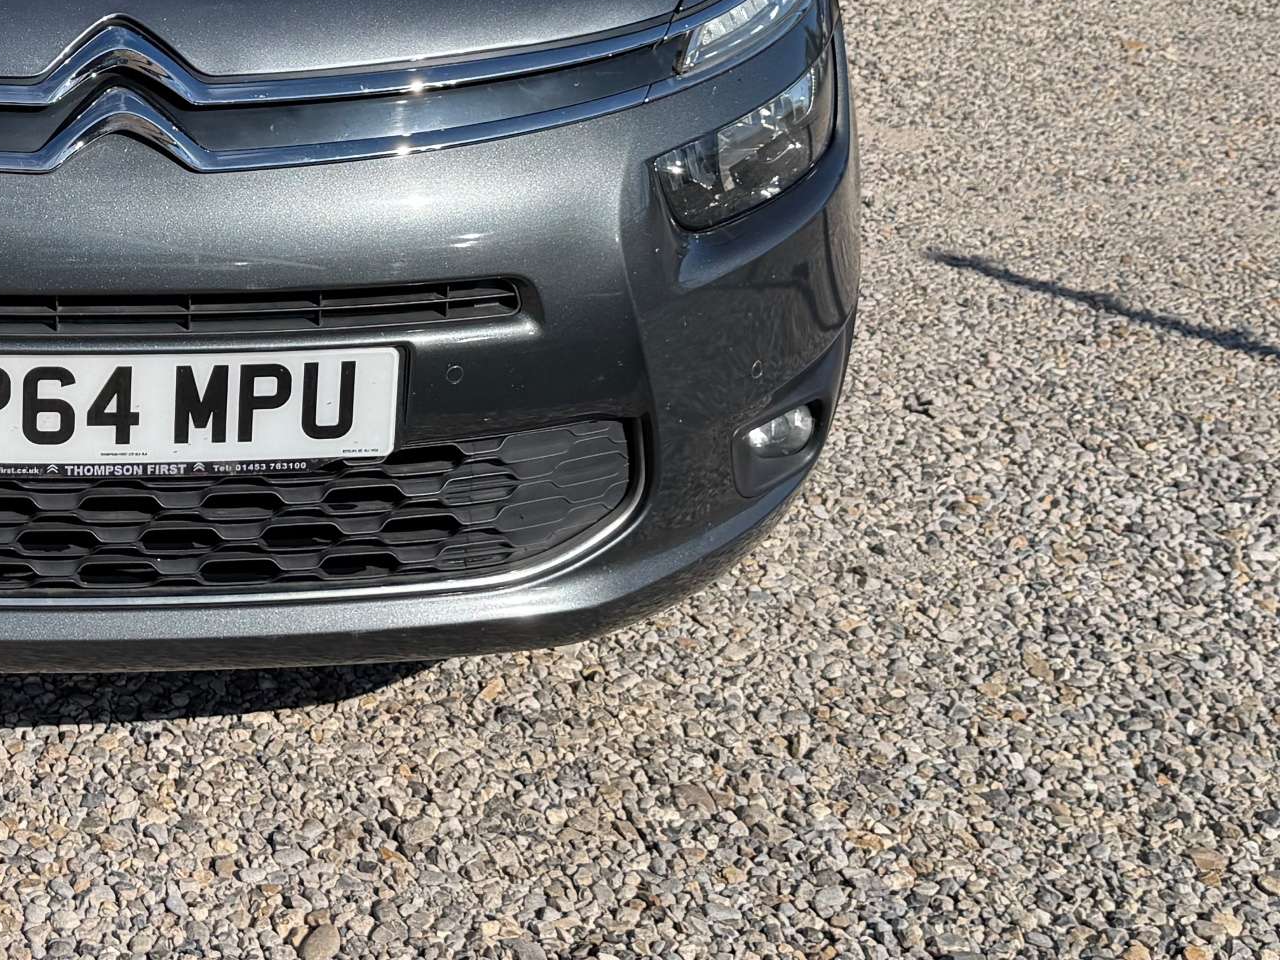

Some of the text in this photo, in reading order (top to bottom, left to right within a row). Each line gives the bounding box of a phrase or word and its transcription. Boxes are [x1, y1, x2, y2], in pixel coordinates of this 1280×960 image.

[173, 360, 357, 444] MPU
[65, 464, 143, 476] THOMPSON
[146, 464, 187, 475] FIRST
[235, 463, 266, 472] 01453
